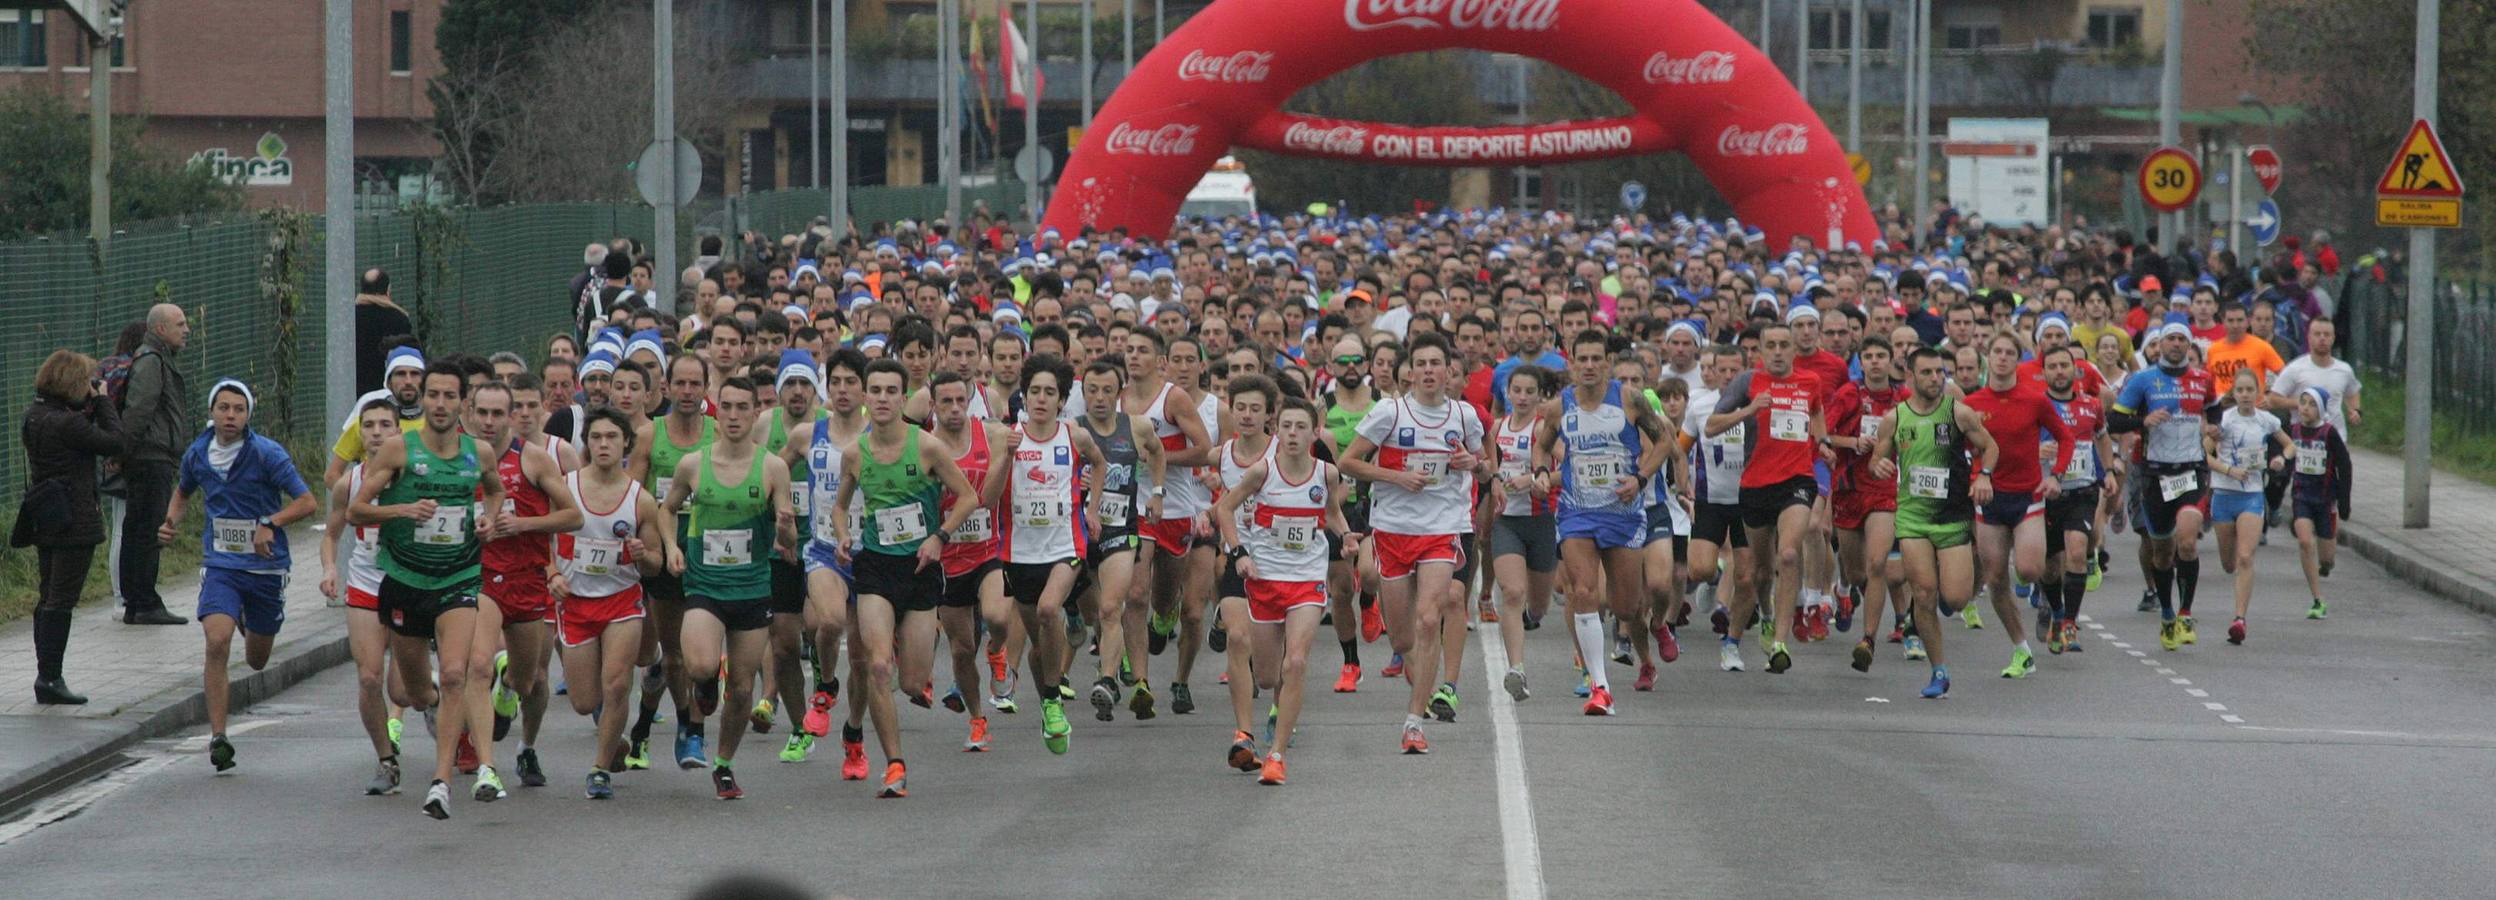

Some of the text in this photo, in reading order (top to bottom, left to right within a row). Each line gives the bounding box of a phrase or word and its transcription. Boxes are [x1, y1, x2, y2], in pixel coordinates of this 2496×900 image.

[1373, 134, 1413, 158] CON
[1416, 136, 1440, 158] EL
[1443, 135, 1525, 159] DEPORTE
[1529, 126, 1632, 156] ASTURIANO
[2154, 168, 2185, 188] 30
[1787, 418, 1793, 431] 5
[1423, 462, 1437, 475] 67
[1588, 463, 1608, 477] 297
[1919, 474, 1938, 488] 260
[1031, 502, 1046, 516] 23
[438, 517, 447, 532] 2
[895, 517, 904, 532] 3
[221, 528, 246, 543] 1088
[1287, 526, 1303, 541] 65
[724, 540, 732, 555] 4
[590, 548, 606, 564] 77
